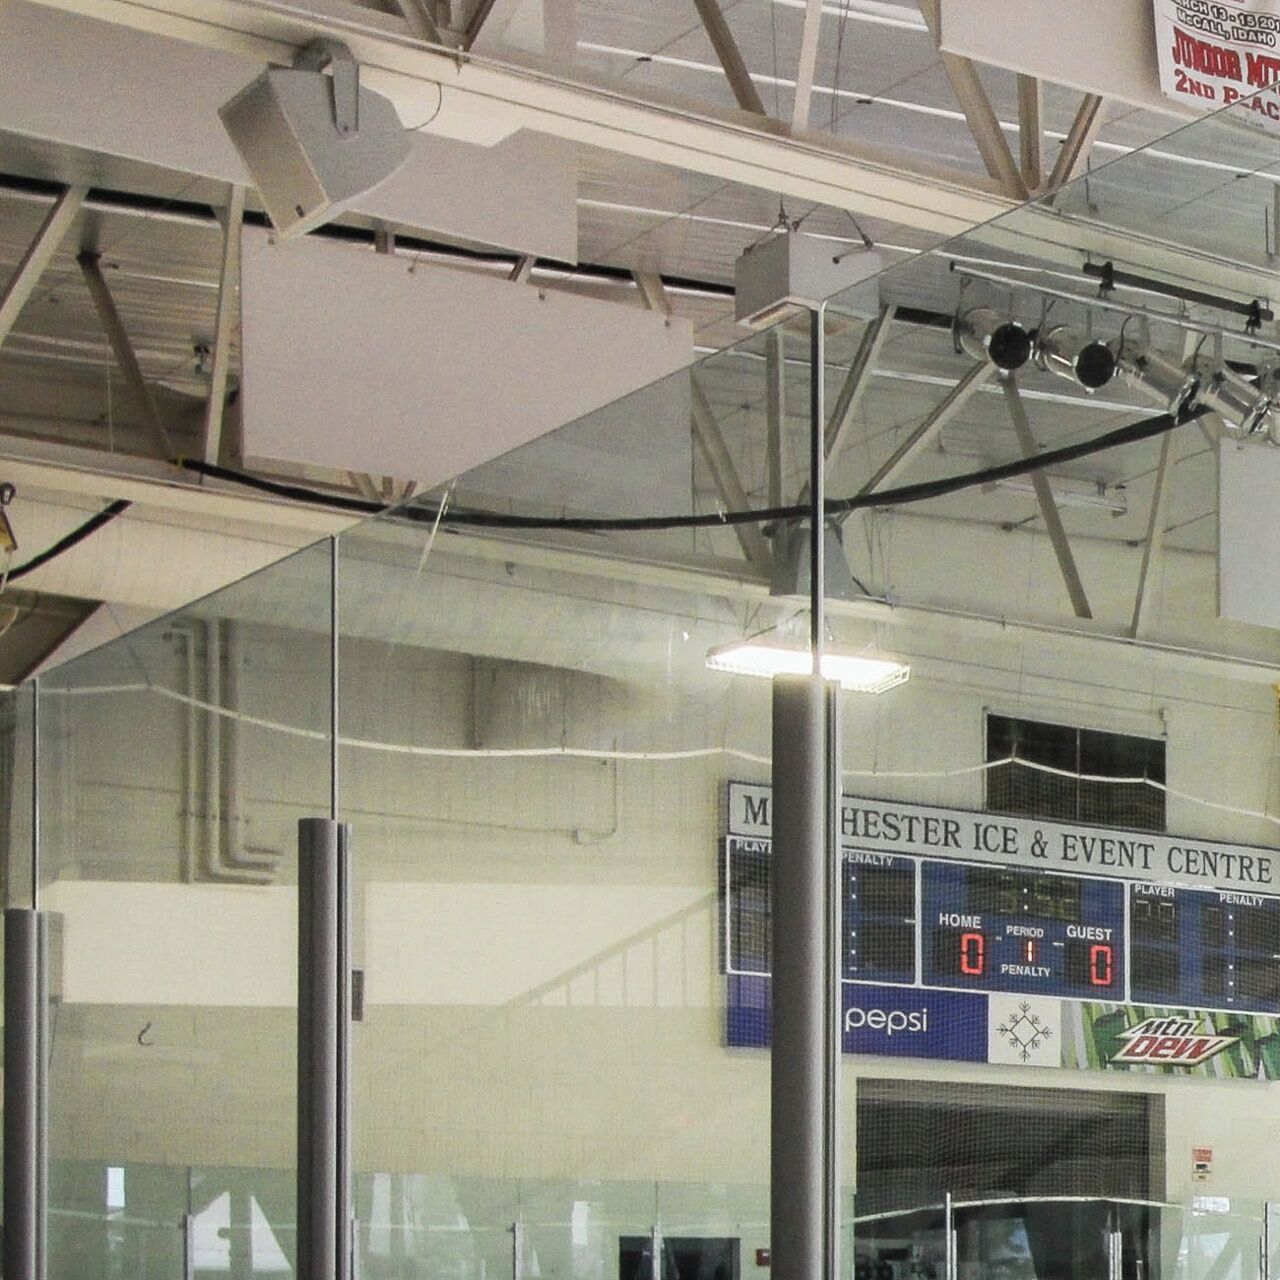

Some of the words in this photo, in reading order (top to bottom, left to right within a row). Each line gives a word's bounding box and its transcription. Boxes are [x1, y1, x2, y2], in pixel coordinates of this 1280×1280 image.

[1211, 6, 1228, 21] 13
[1238, 13, 1257, 27] 15
[1232, 27, 1276, 47] IDAHO
[1172, 26, 1242, 82] JUNIOR
[1174, 68, 1215, 100] 2ND
[743, 794, 962, 850] MHESTER
[974, 822, 1019, 854] ICE
[1031, 829, 1048, 858] &
[1061, 834, 1155, 869] EVENT
[1167, 846, 1272, 884] CENTRE
[1135, 884, 1175, 897] PLAYER
[1220, 893, 1264, 907] PENALTY
[939, 913, 982, 929] HOME
[1006, 925, 1044, 938] PERIOD
[1067, 925, 1112, 941] GUEST
[961, 933, 984, 975] 0
[1028, 940, 1033, 962] 1
[1001, 963, 1051, 977] PENALTY
[1090, 945, 1112, 985] 0
[845, 1006, 928, 1035] pepsi
